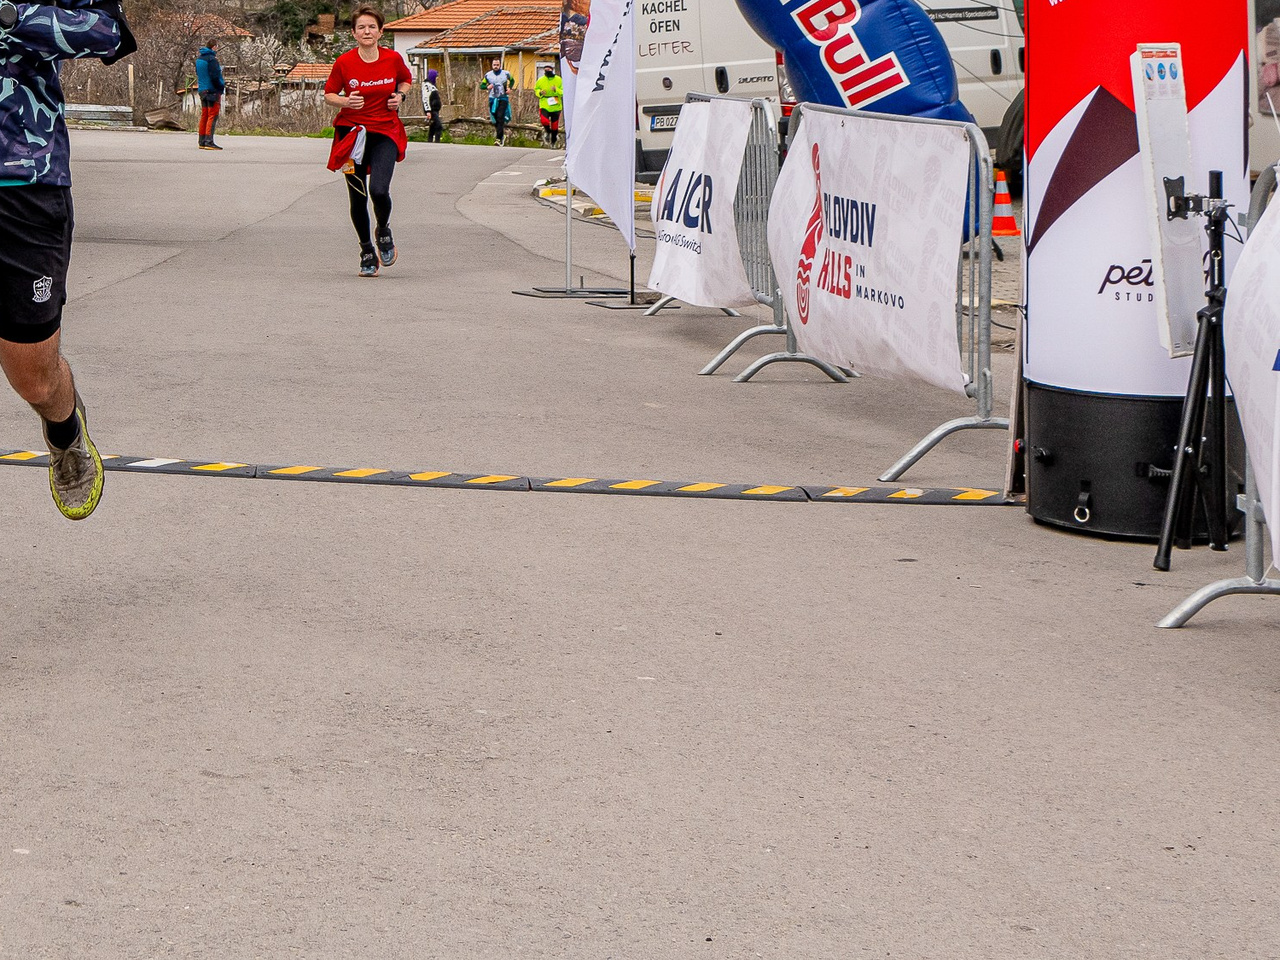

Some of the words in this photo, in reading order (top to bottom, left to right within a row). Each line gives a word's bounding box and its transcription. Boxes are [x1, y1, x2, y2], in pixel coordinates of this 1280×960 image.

[642, 0, 688, 16] KACHEL
[649, 18, 681, 34] ÖFEN
[638, 40, 695, 58] LEITER
[738, 75, 775, 85] DUCATO
[816, 247, 853, 300] HLLS
[855, 263, 866, 279] IN
[855, 284, 905, 310] MARKOVO
[1115, 291, 1153, 302] STUD
